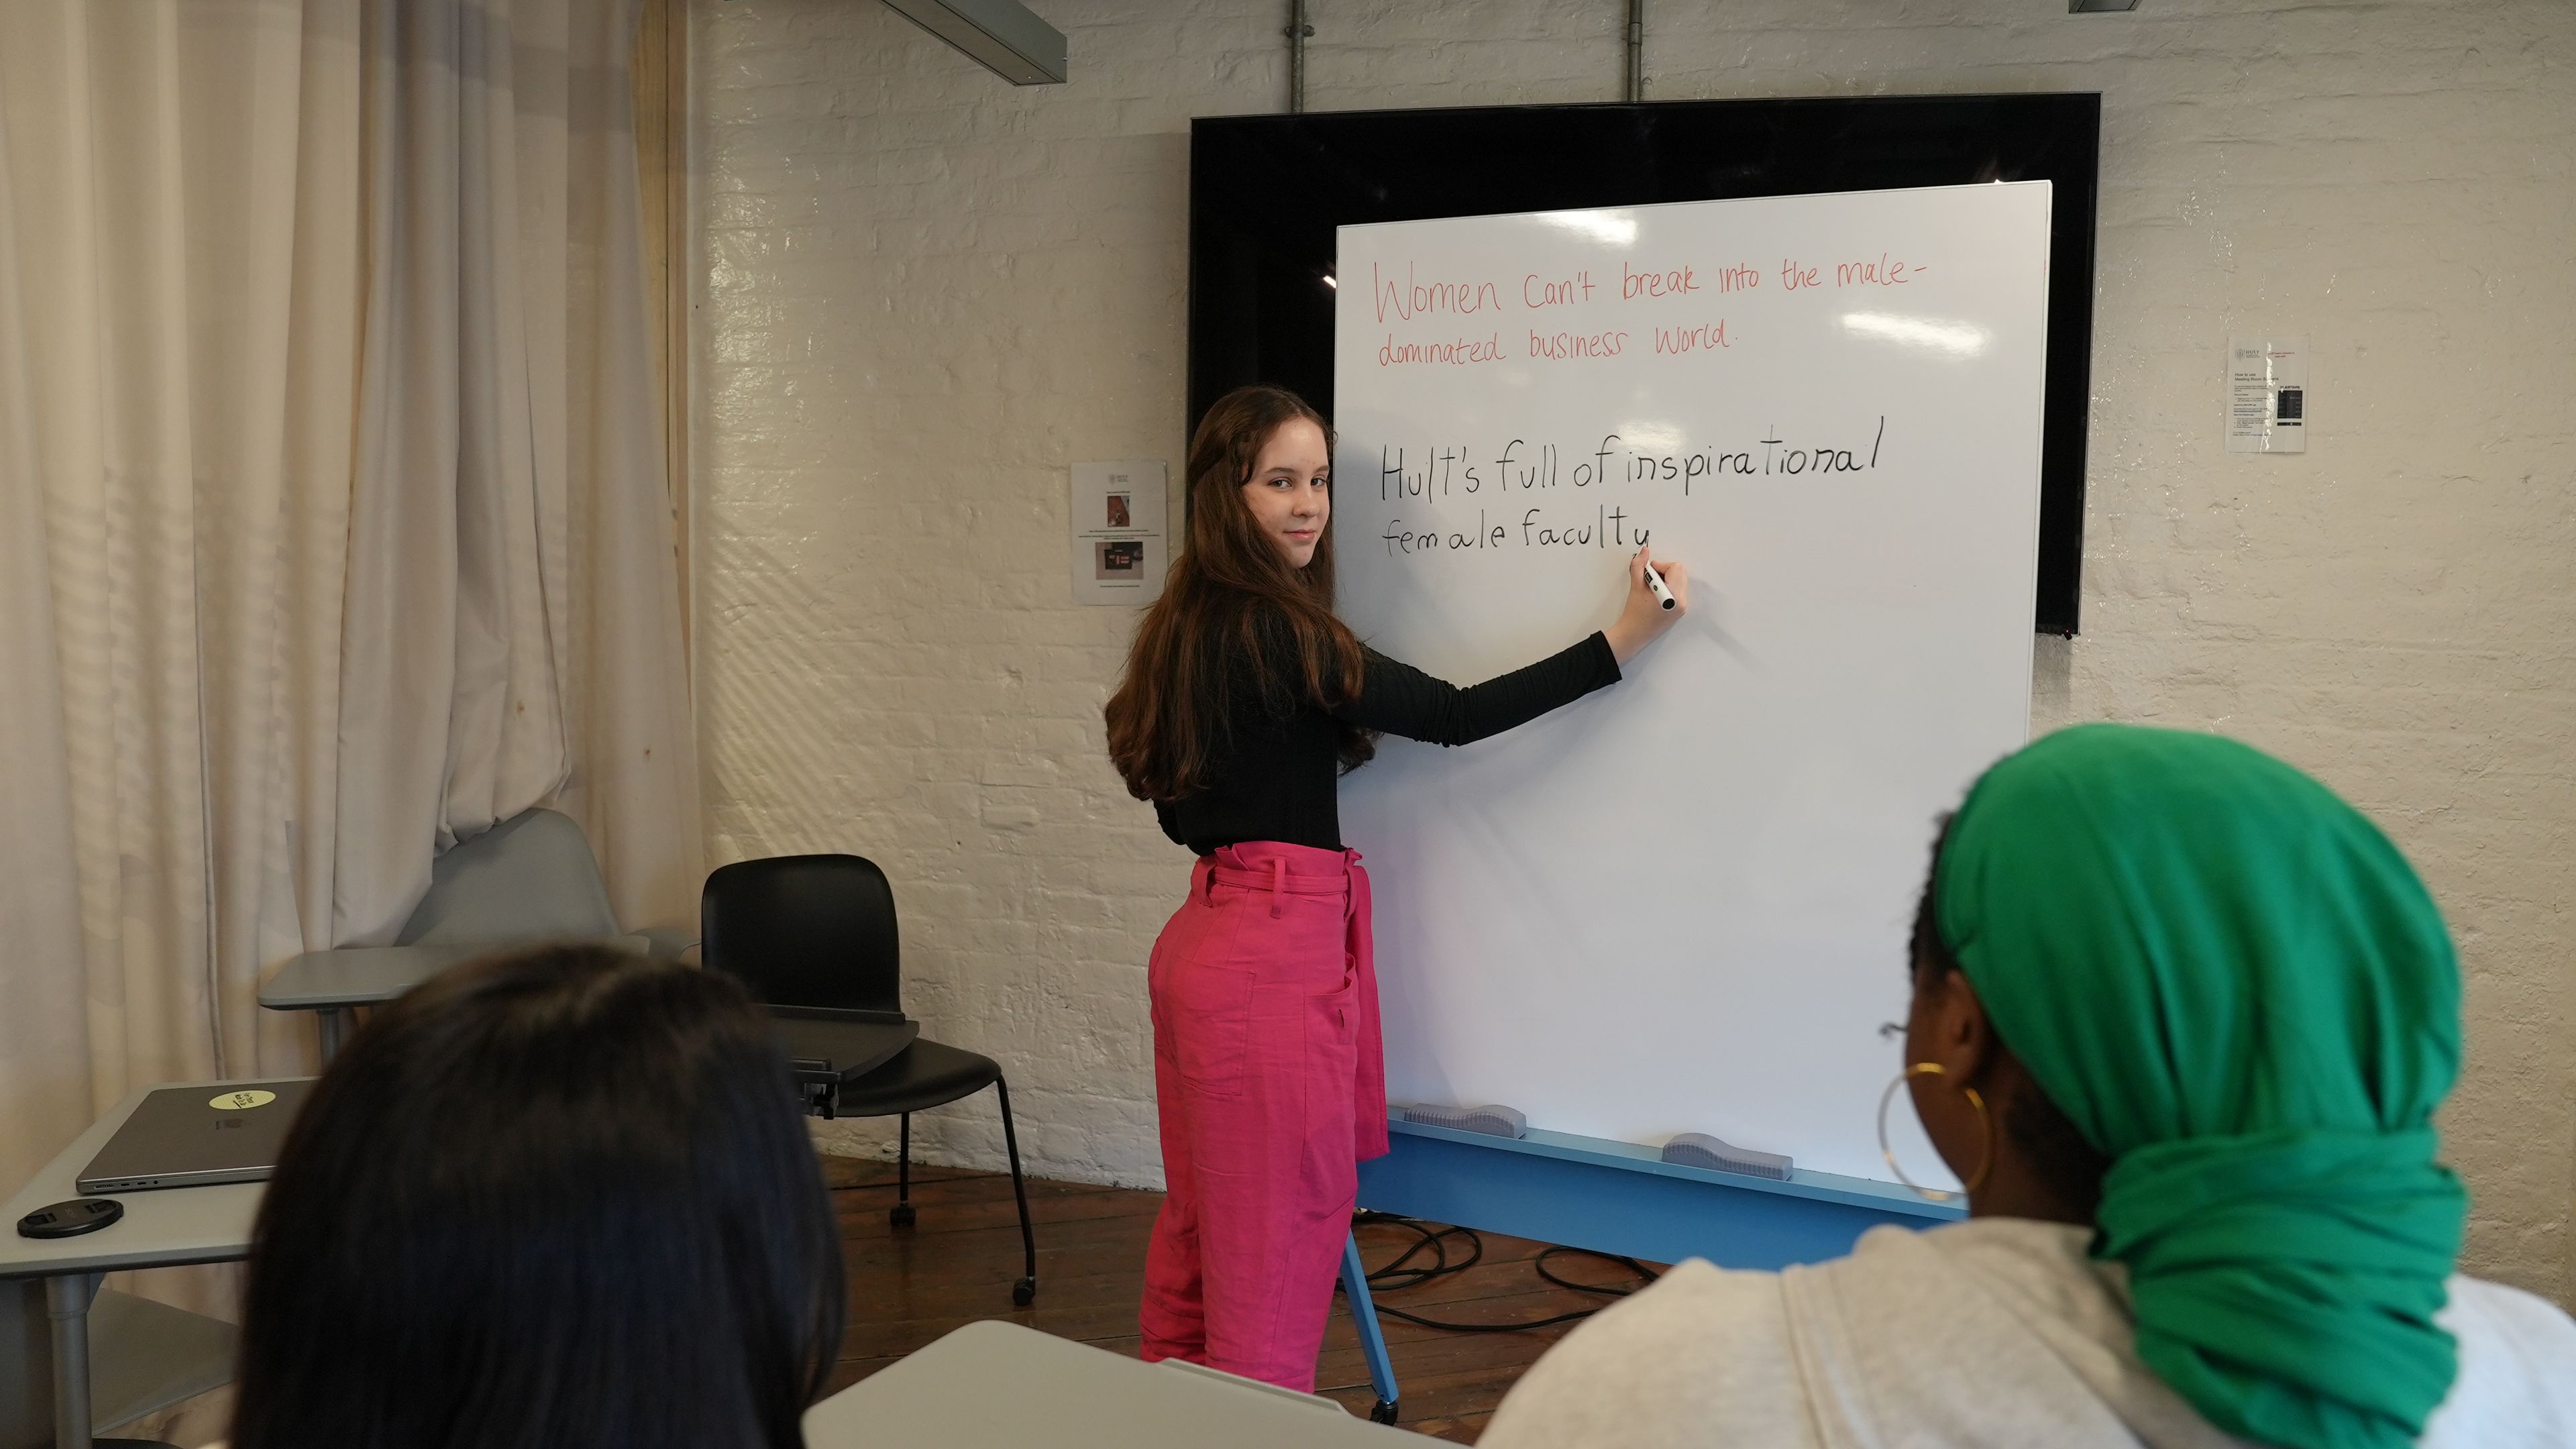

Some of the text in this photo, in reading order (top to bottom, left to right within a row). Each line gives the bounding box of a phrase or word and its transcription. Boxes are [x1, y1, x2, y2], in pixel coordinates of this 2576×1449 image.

[1374, 260, 1501, 323] Women
[1623, 261, 1700, 301] break
[1719, 262, 1759, 293] into
[1781, 258, 1822, 290] the
[1837, 252, 1927, 288] male-
[1379, 332, 1507, 367] dominated
[1530, 327, 1629, 360] business
[1382, 415, 1884, 504] Hult's full of inspirational
[1381, 508, 1505, 557] female
